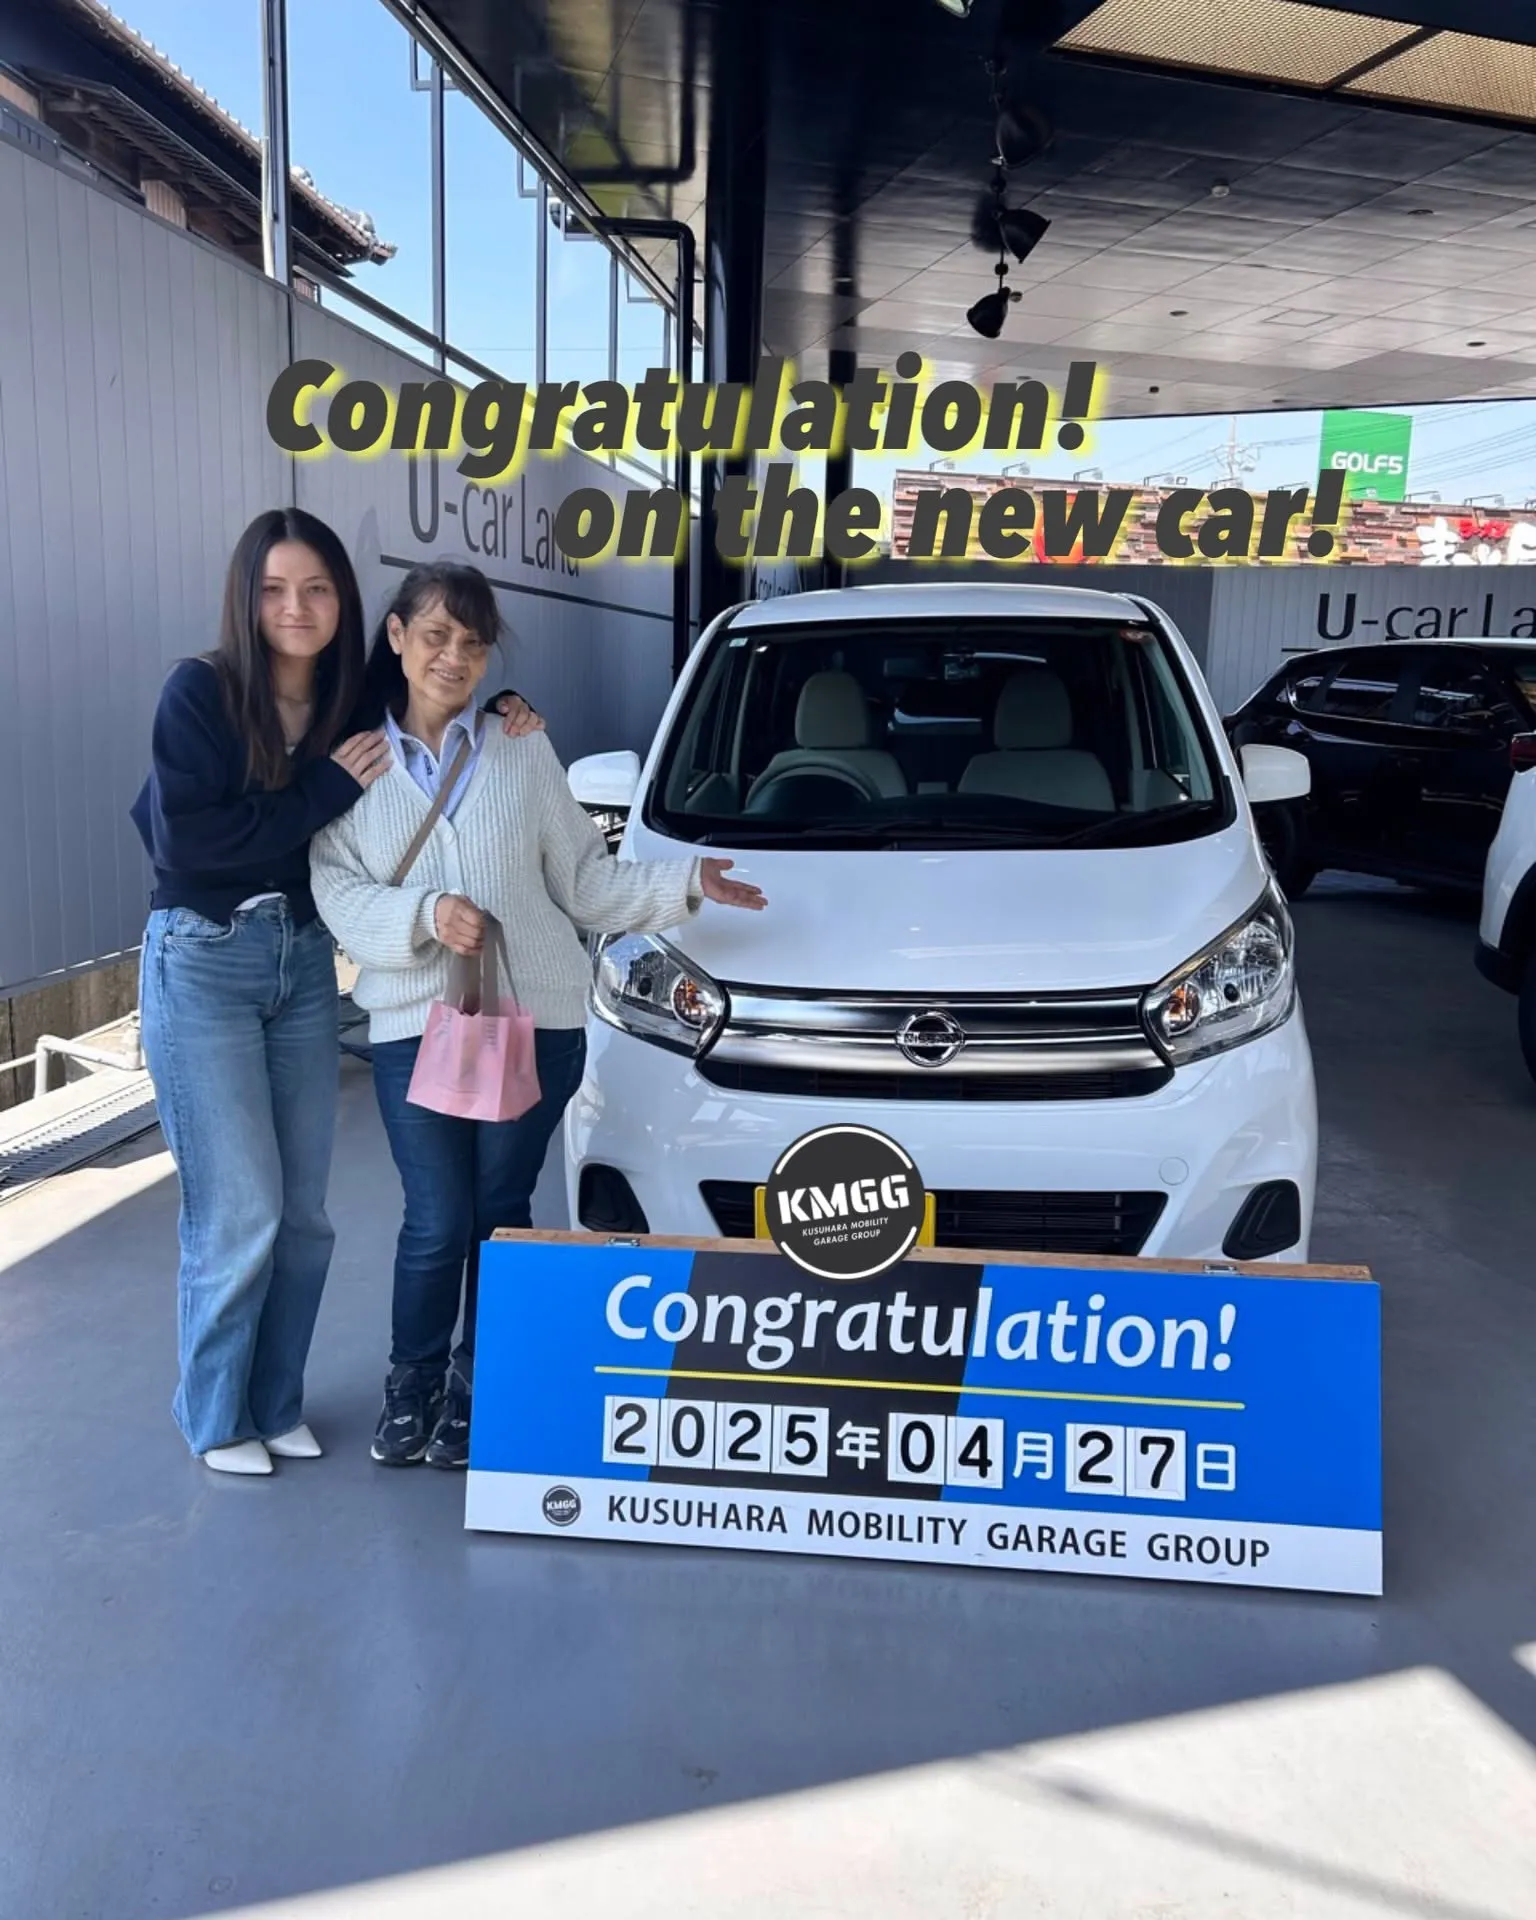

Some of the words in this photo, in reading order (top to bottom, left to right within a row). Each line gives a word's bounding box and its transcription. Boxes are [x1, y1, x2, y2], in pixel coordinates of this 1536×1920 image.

[1317, 593, 1468, 641] U-car
[606, 1275, 1236, 1371] Congratulation!
[608, 1495, 788, 1534] KUSUHARA
[807, 1508, 967, 1545] MOBILITY
[987, 1522, 1127, 1558] GARAGE
[1147, 1532, 1270, 1567] GROUP
